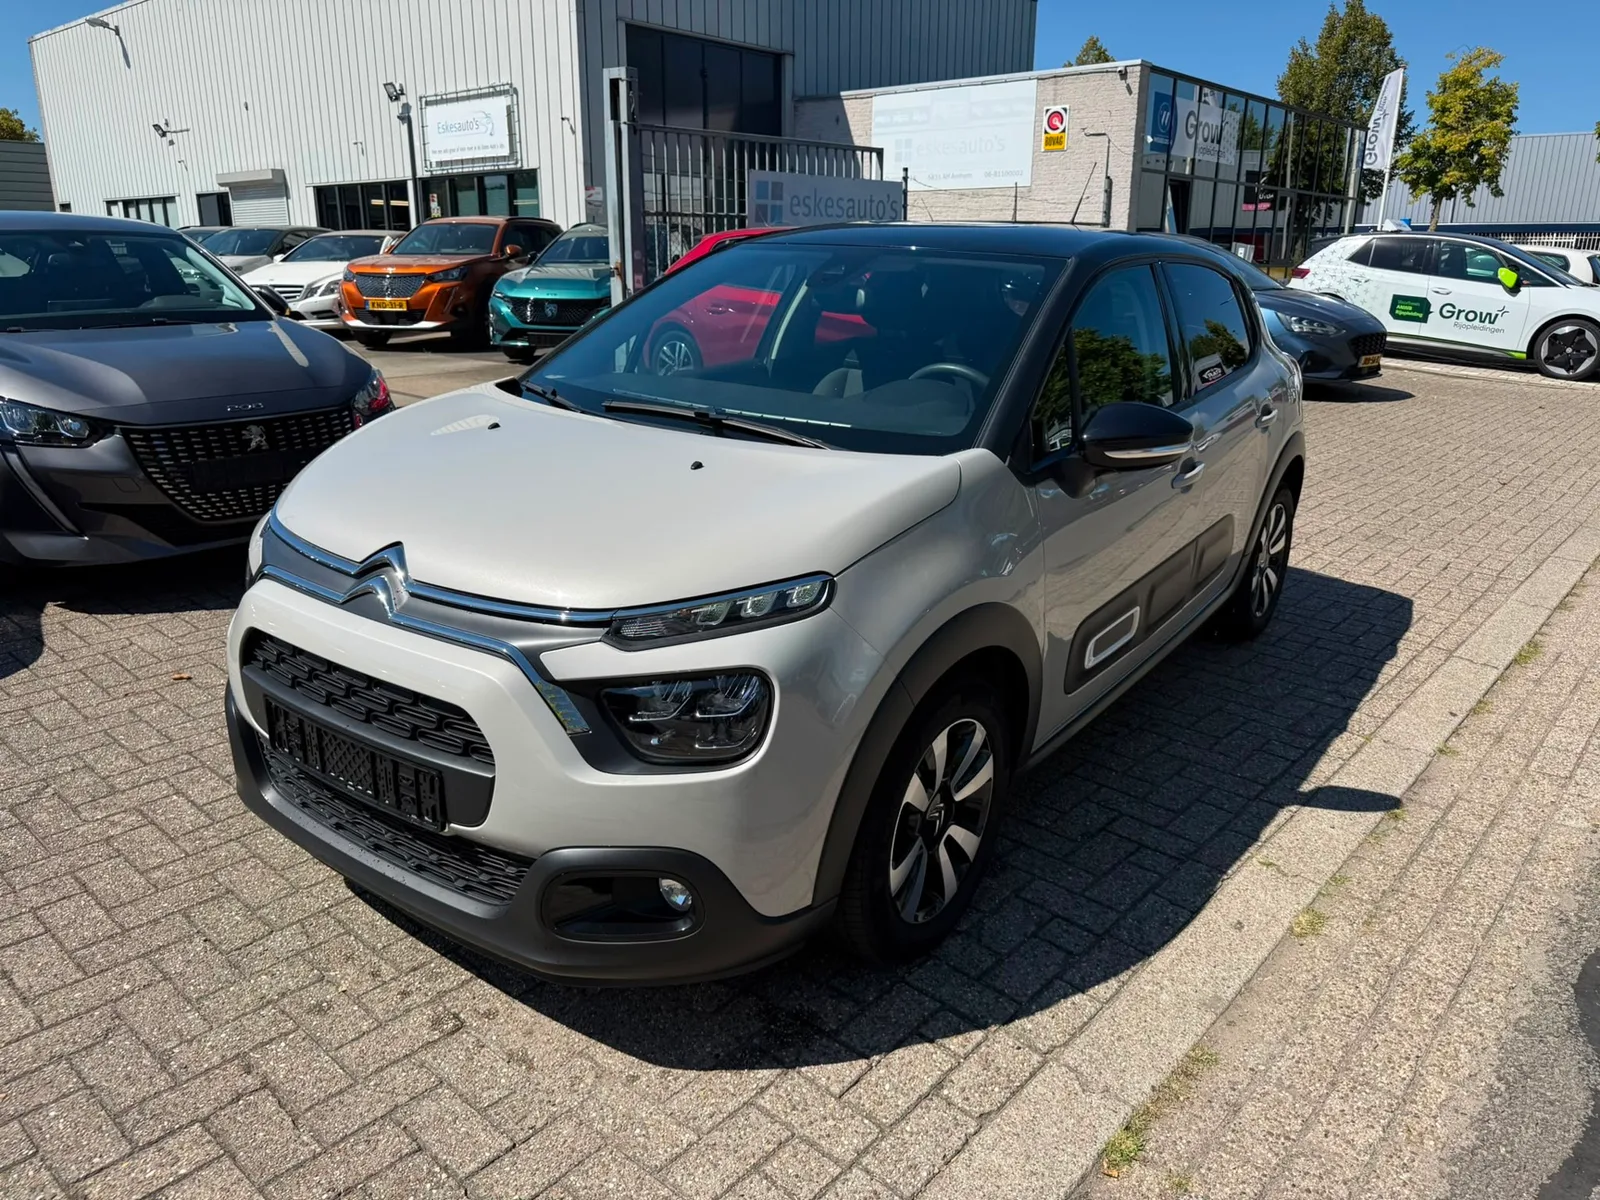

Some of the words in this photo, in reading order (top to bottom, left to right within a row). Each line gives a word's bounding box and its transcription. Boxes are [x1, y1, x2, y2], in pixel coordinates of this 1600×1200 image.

[437, 117, 480, 134] Eskesauto's
[916, 134, 1006, 158] eskesauto's
[1044, 135, 1064, 147] BOVAG
[789, 188, 898, 220] eskesauto's
[1439, 303, 1499, 324] Grow
[1453, 321, 1505, 334] Rijopleidingen
